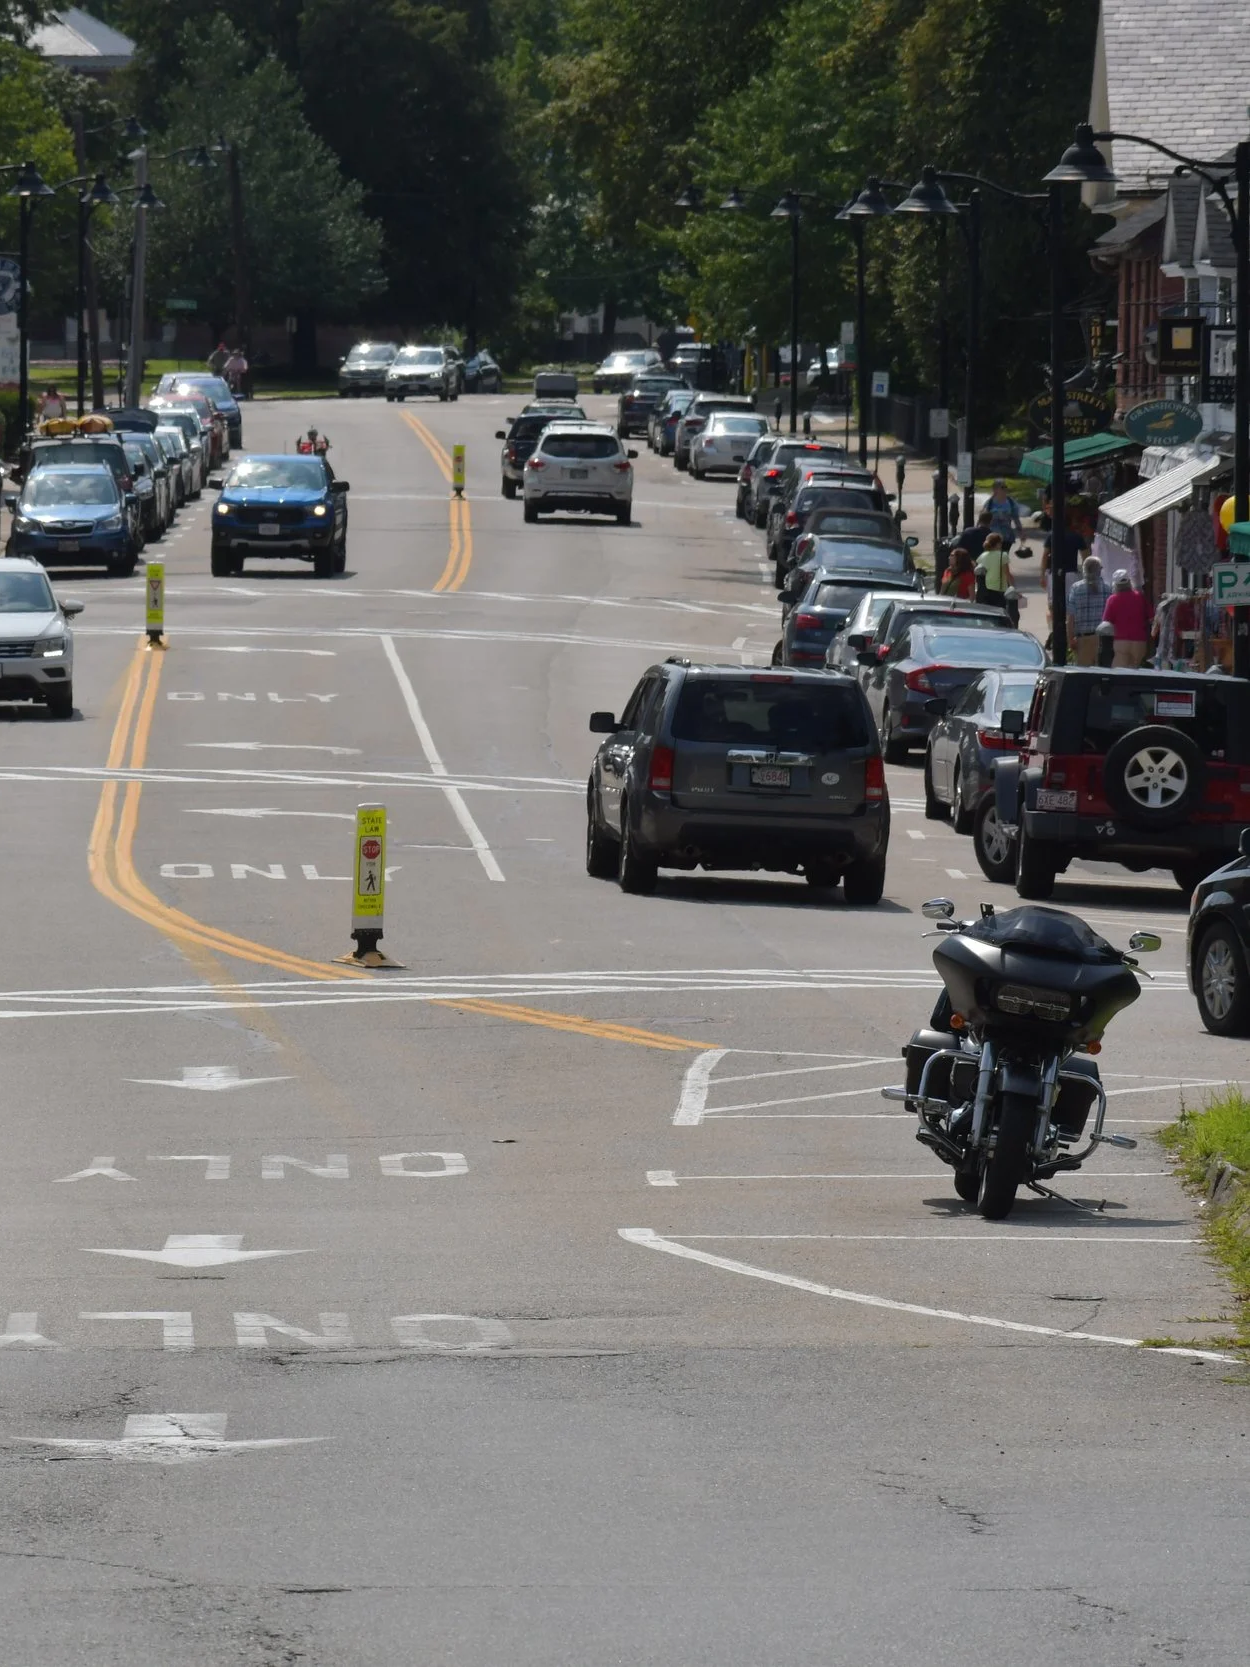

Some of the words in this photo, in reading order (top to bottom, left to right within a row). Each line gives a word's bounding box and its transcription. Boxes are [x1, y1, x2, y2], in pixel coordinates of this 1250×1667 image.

[1129, 401, 1198, 421] GRASSHOPPER
[1145, 435, 1179, 445] SHOP
[166, 691, 339, 703] ONLY
[361, 817, 382, 825] STATE
[362, 844, 380, 855] STOP
[51, 1152, 469, 1183] ONLY
